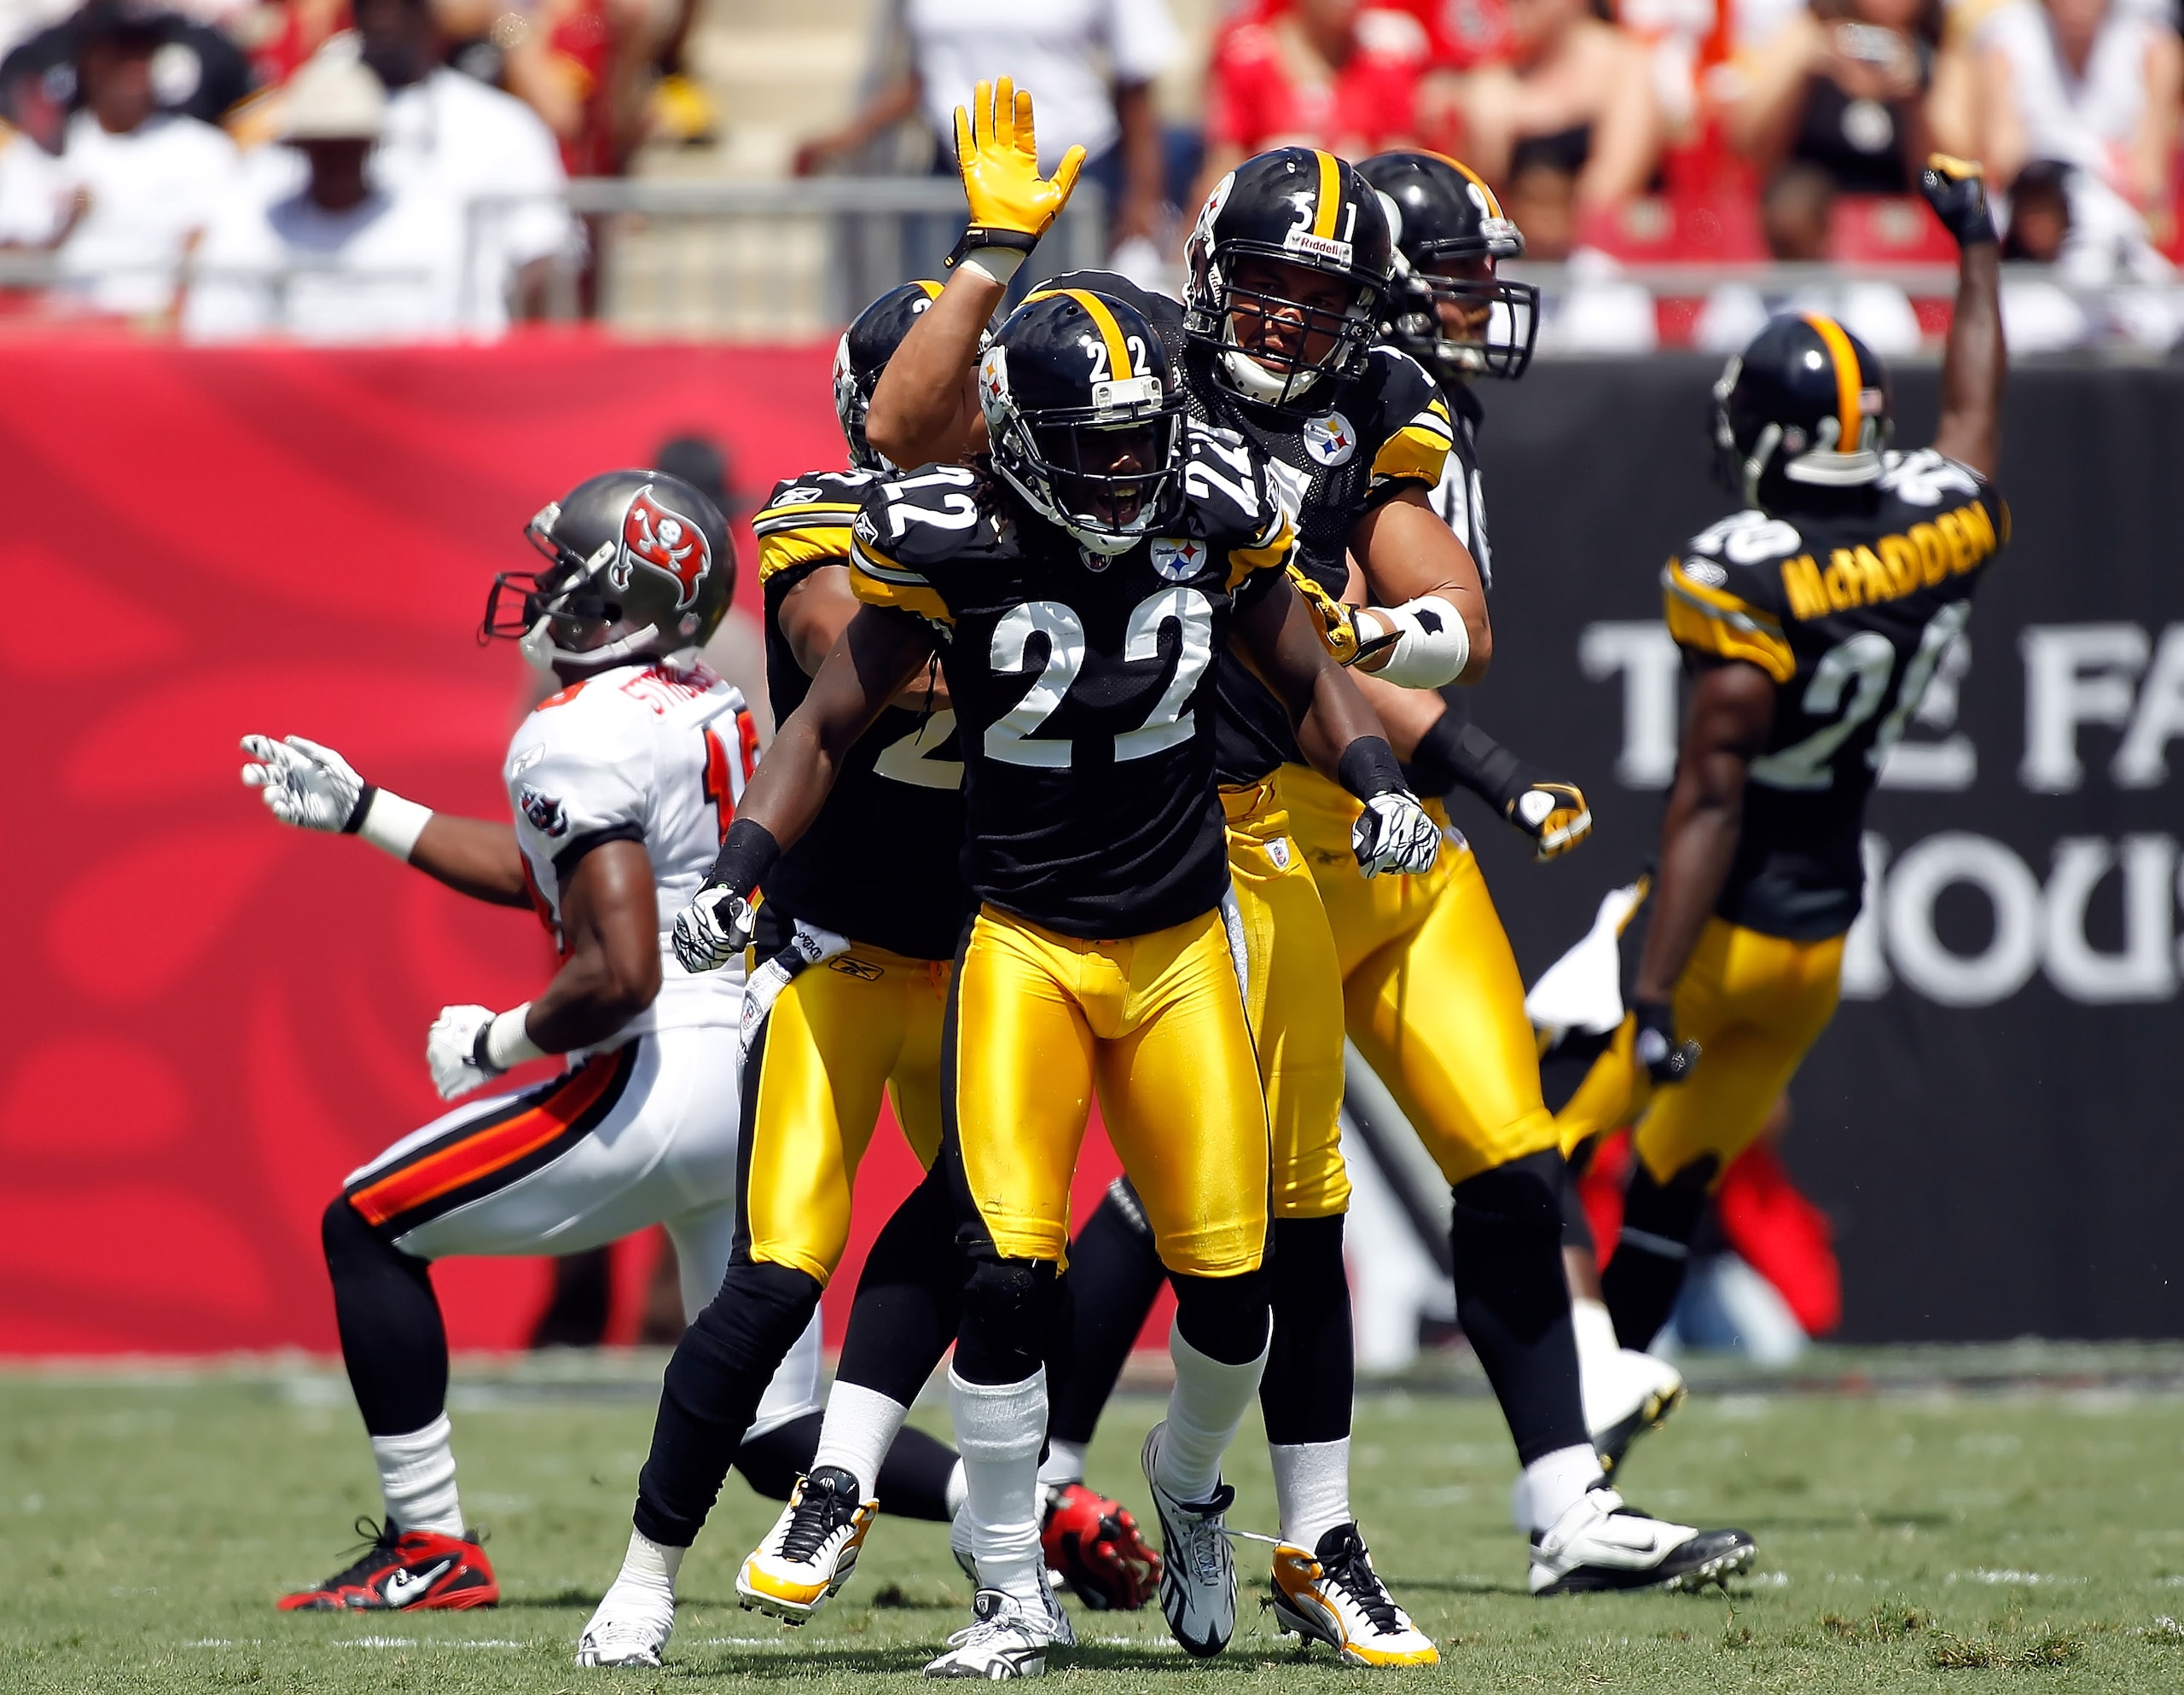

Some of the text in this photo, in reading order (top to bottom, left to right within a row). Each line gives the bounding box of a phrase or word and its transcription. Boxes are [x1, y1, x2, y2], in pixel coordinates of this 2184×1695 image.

[1290, 190, 1358, 243] 51
[1301, 237, 1339, 255] Riddell
[1086, 335, 1151, 383] 22
[984, 586, 1213, 768] 22
